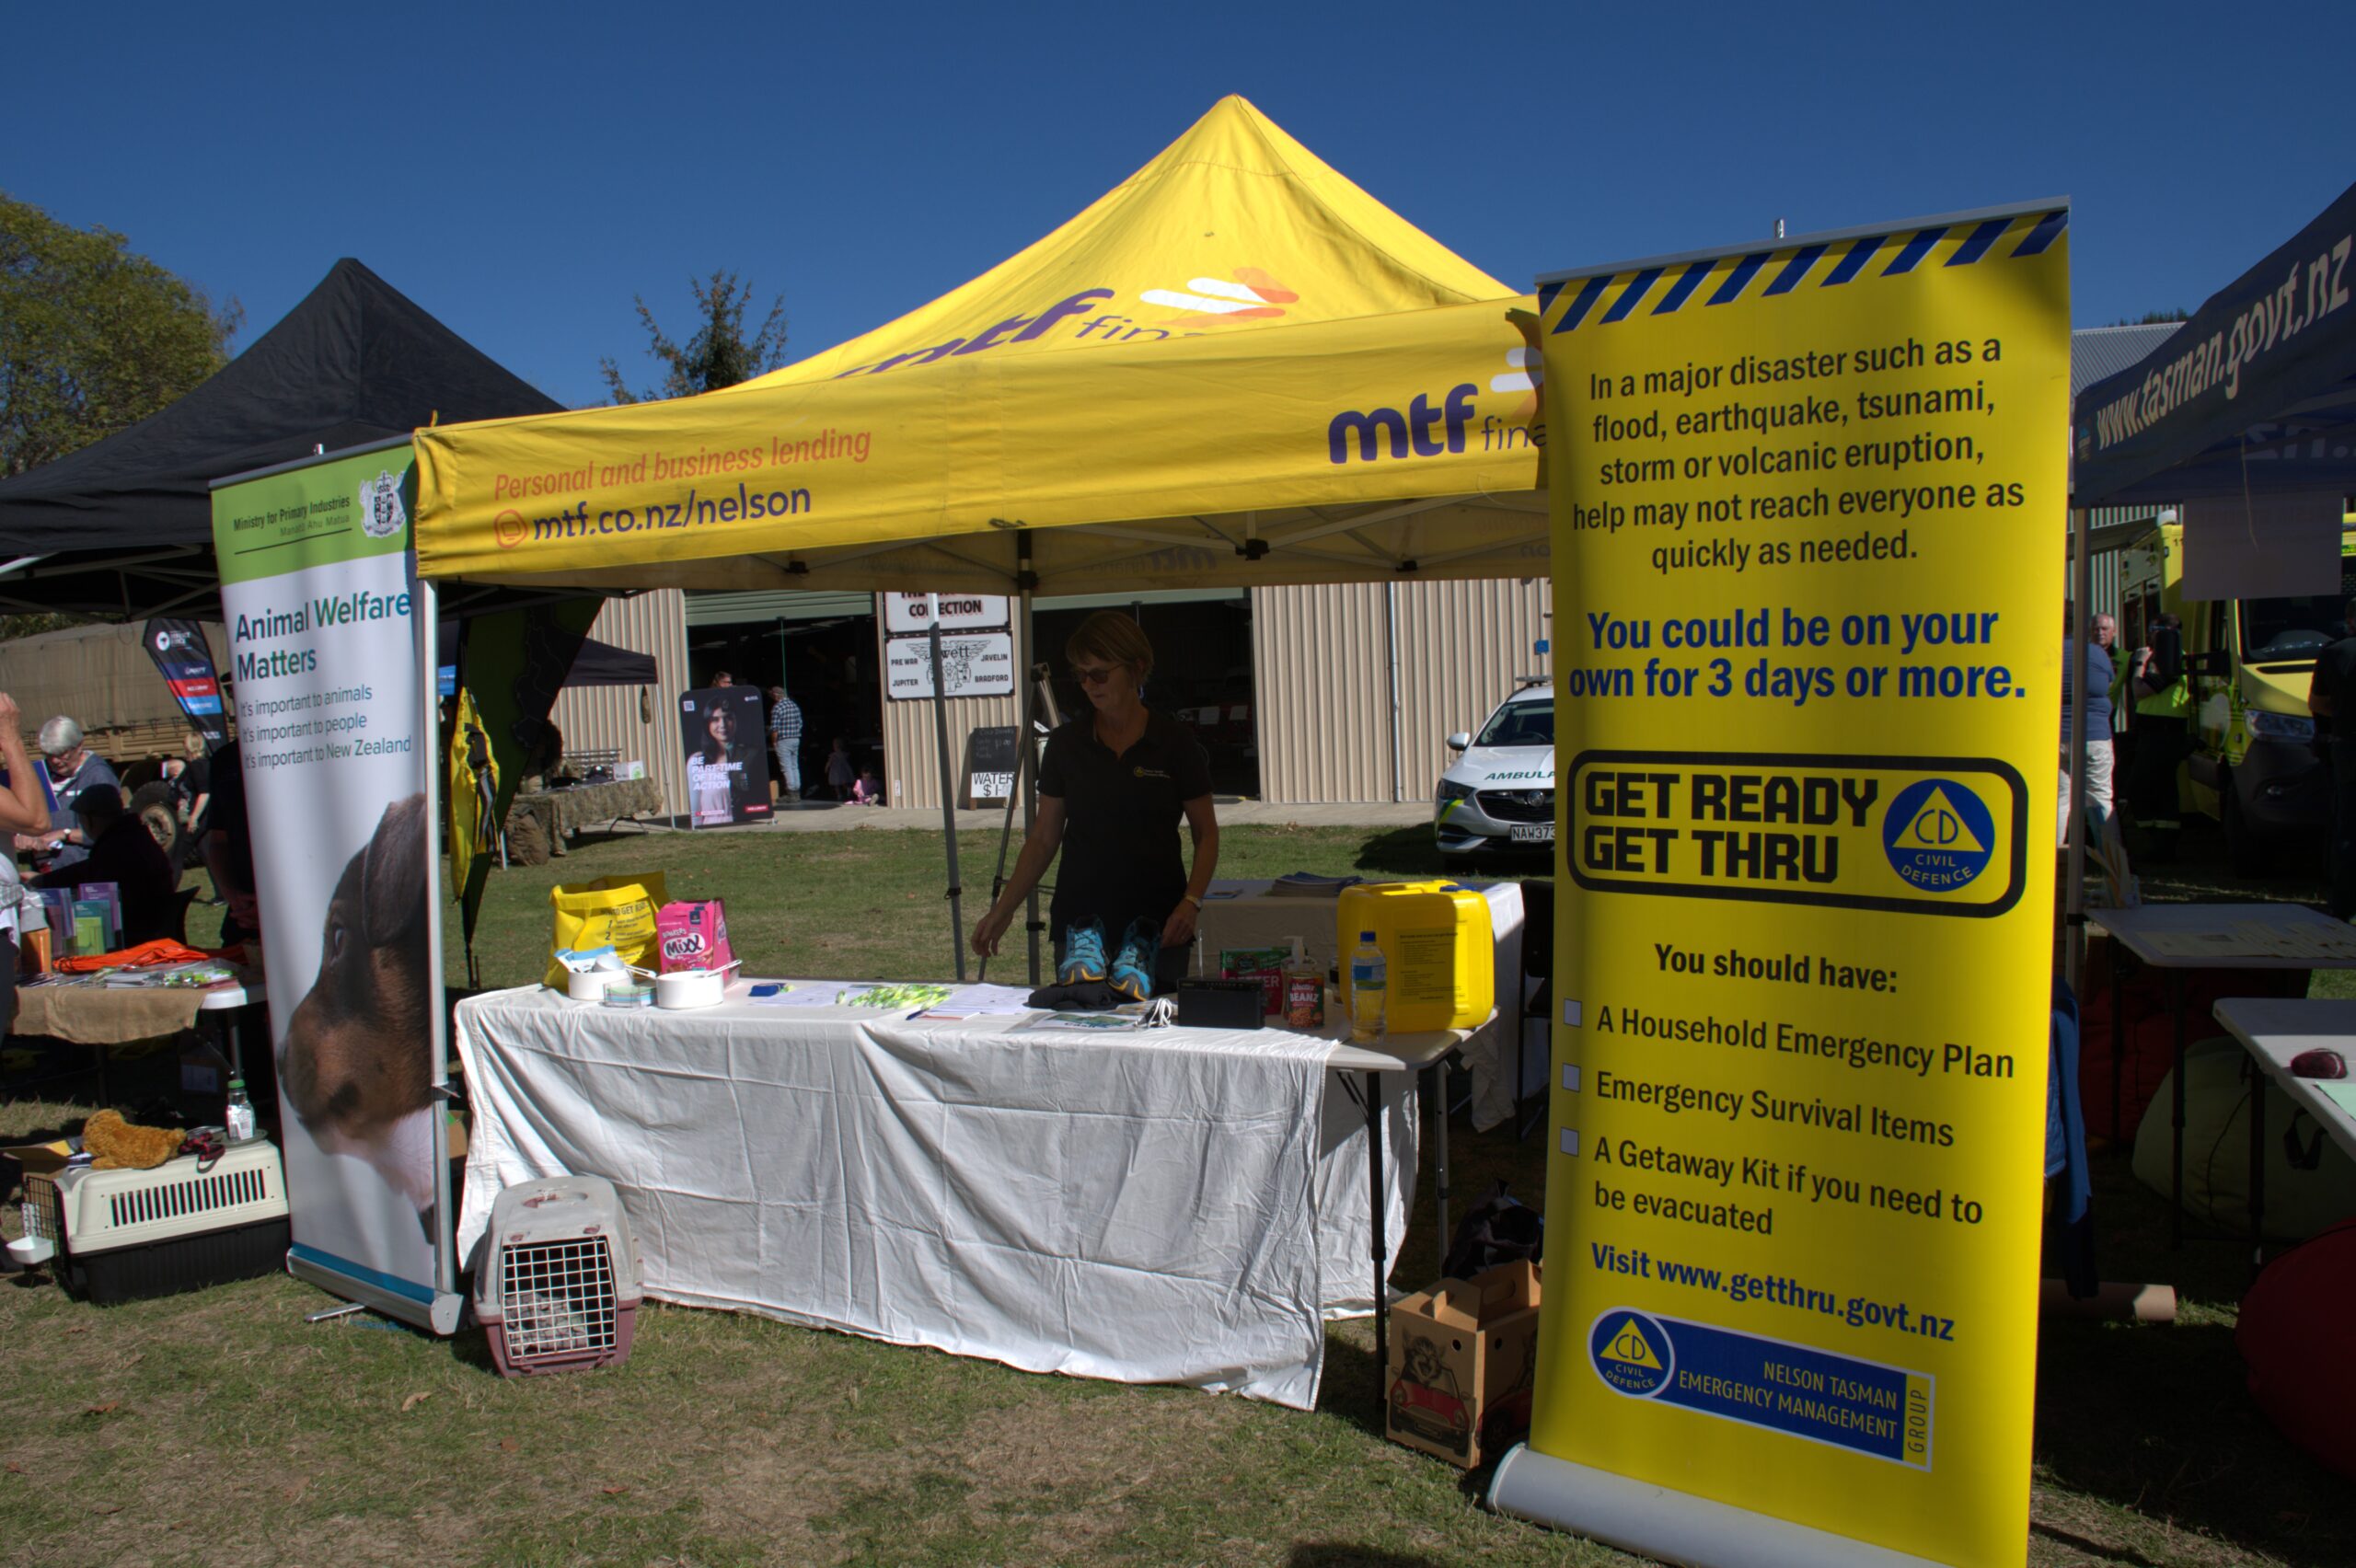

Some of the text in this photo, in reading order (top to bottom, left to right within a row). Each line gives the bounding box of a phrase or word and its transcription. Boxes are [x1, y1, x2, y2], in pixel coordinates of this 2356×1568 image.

[2096, 234, 2352, 451] www.tasman.govt.nz
[1590, 337, 2002, 400] In a major disaster such as a
[1328, 383, 1479, 465] mtf
[1592, 380, 1995, 444] flood, earthquake, tsunami,
[493, 428, 872, 502] Personal and business lending
[1600, 431, 1984, 486] storm or volcanic eruption,
[233, 495, 352, 532] Ministry for Primary Industries
[533, 481, 812, 542] mtf.co.nz/nelson
[1573, 501, 1625, 534] help
[1634, 499, 1689, 531] may
[1696, 493, 1742, 524] not
[1750, 487, 1830, 520] reach
[1838, 481, 1977, 518] everyone
[1985, 481, 2026, 507] as
[1651, 528, 1918, 575] quickly as needed.
[235, 601, 310, 643] Animal
[314, 591, 411, 628] Welfare
[908, 599, 983, 617] COECTION
[1587, 607, 1999, 655] You could be on your
[237, 648, 318, 683] Matters
[890, 658, 918, 666] PRE WAR
[924, 645, 970, 662] Jwett
[980, 653, 1009, 663] JAVELIN
[892, 678, 918, 687] JUPITER
[974, 674, 1010, 683] BRADFORD
[1569, 658, 2027, 707] own for 3 days or more.
[255, 693, 312, 718] important
[312, 691, 322, 707] to
[324, 685, 373, 706] animals
[256, 720, 313, 744] important
[313, 720, 323, 734] to
[325, 712, 367, 737] people
[258, 746, 314, 770] important
[314, 746, 325, 761] to
[325, 743, 352, 760] New
[353, 734, 412, 756] Zealand
[691, 762, 744, 774] PART-TIME
[692, 755, 706, 766] BE
[692, 772, 729, 782] OF THE
[692, 780, 731, 791] ACTION
[974, 773, 1014, 785] WATER
[1584, 770, 1879, 828] GET READY
[1915, 808, 1959, 845] CD
[1583, 824, 1840, 884] GET THRU
[1915, 853, 1958, 868] CIVIL
[1900, 864, 1974, 885] DEFENCE
[664, 935, 703, 956] Mixx
[1654, 943, 1898, 994] You should have:
[1289, 992, 1320, 1003] BEANZ
[1597, 1005, 2015, 1078] A Household Emergency Plan
[1597, 1071, 1955, 1147] Emergency Survival Items
[1594, 1136, 1983, 1225] A Getaway Kit if you need to
[1594, 1181, 1773, 1235] be evacuated
[1591, 1242, 1956, 1342] Visit www.getthru.govt.nz
[1615, 1332, 1646, 1361] CD
[1605, 1369, 1656, 1389] DEFENCE
[1615, 1364, 1645, 1378] CIVIL
[1763, 1361, 1898, 1411] NELSON TASMAN
[1678, 1369, 1898, 1440] EMERGENCY MANAGEMENT
[1908, 1389, 1927, 1454] GROUP
